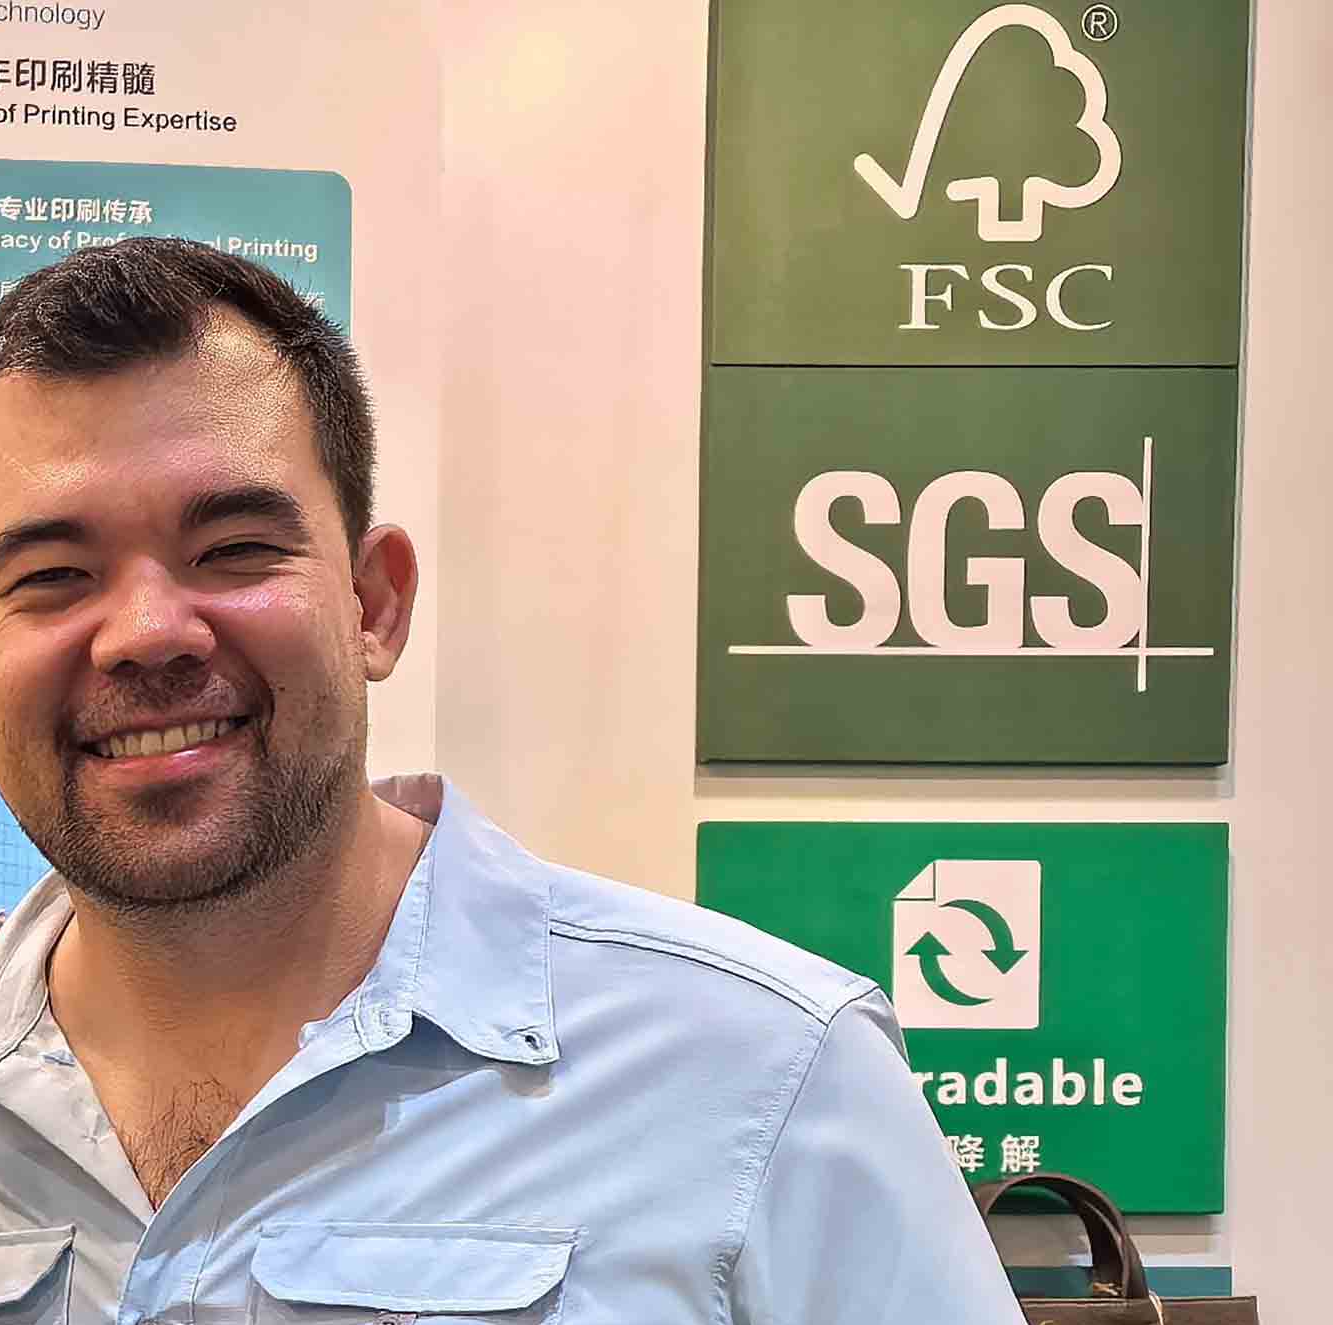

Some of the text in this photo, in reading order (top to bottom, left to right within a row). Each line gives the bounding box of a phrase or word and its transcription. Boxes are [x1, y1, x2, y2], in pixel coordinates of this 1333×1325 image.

[24, 104, 115, 131] Printing
[121, 108, 238, 135] Expertise
[48, 230, 71, 250] of
[228, 236, 319, 263] Printing
[898, 263, 1113, 330] FSC
[786, 469, 1146, 651] SGS
[910, 1057, 1144, 1106] radable
[946, 1134, 1042, 1173] 降解
